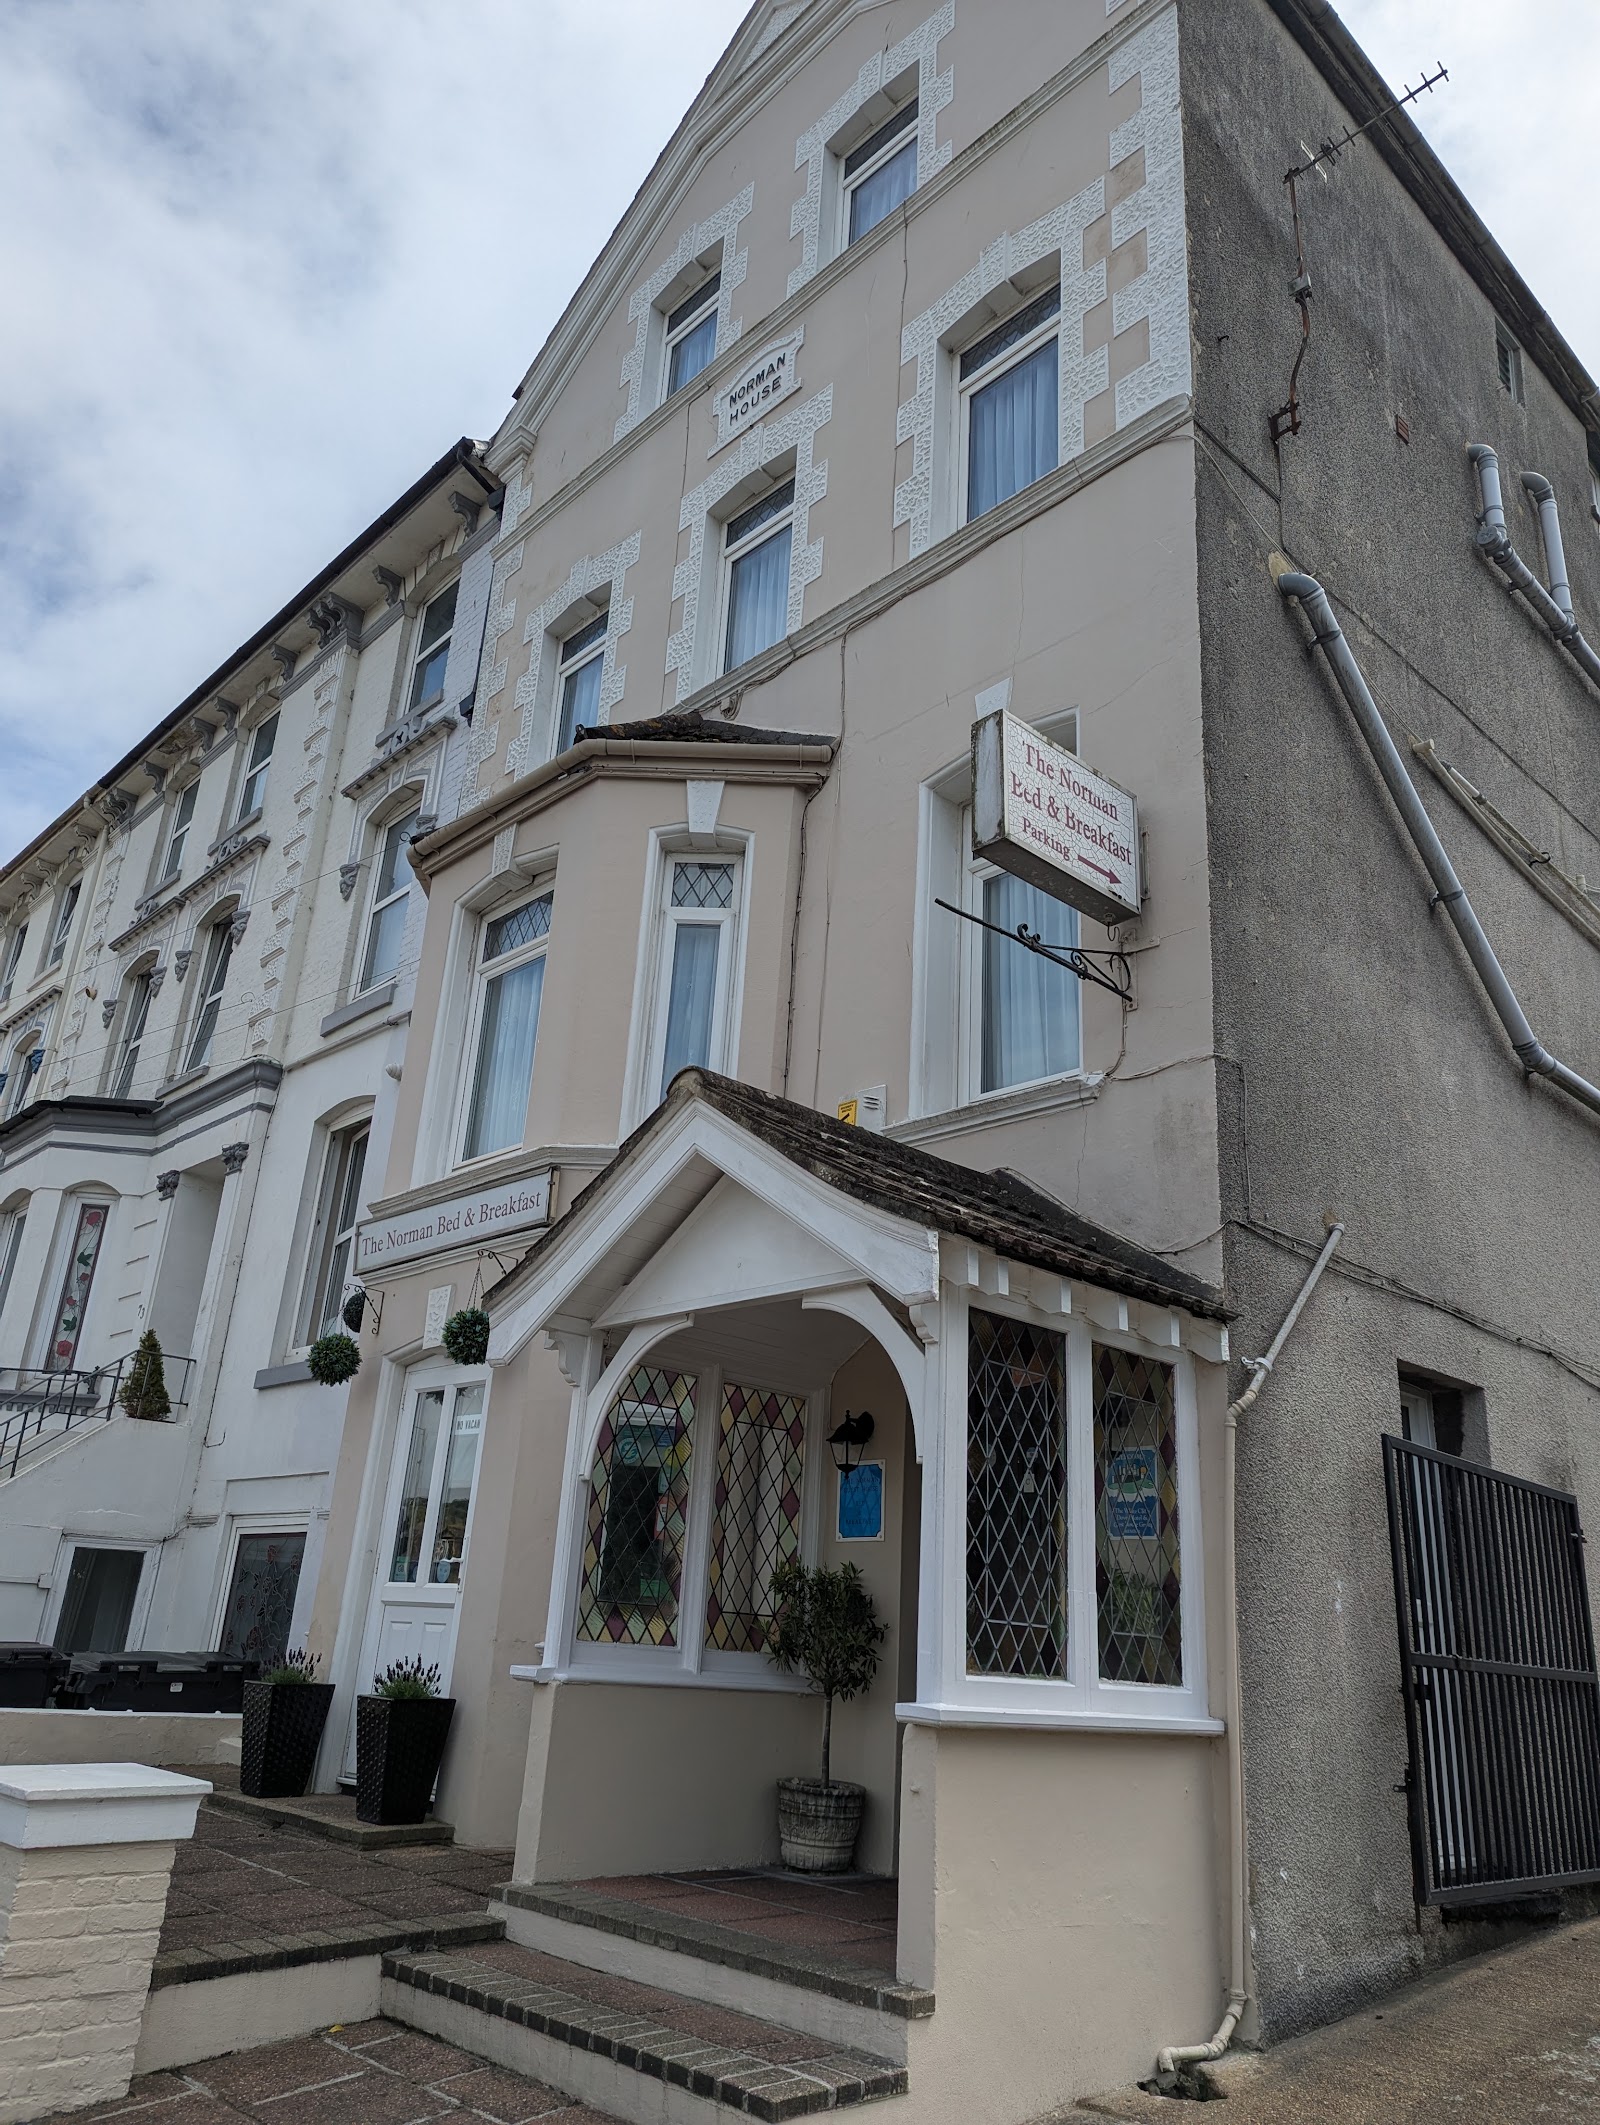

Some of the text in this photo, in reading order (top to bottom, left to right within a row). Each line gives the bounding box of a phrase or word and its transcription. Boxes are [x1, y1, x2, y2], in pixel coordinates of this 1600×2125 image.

[729, 352, 786, 408] NORMAN
[729, 375, 782, 426] HOUSE
[1022, 740, 1119, 821] The Norman
[1010, 771, 1132, 866] Bed & Breakfast
[1022, 817, 1071, 861] Parking
[362, 1191, 541, 1256] The Norman Bed & Breakfast
